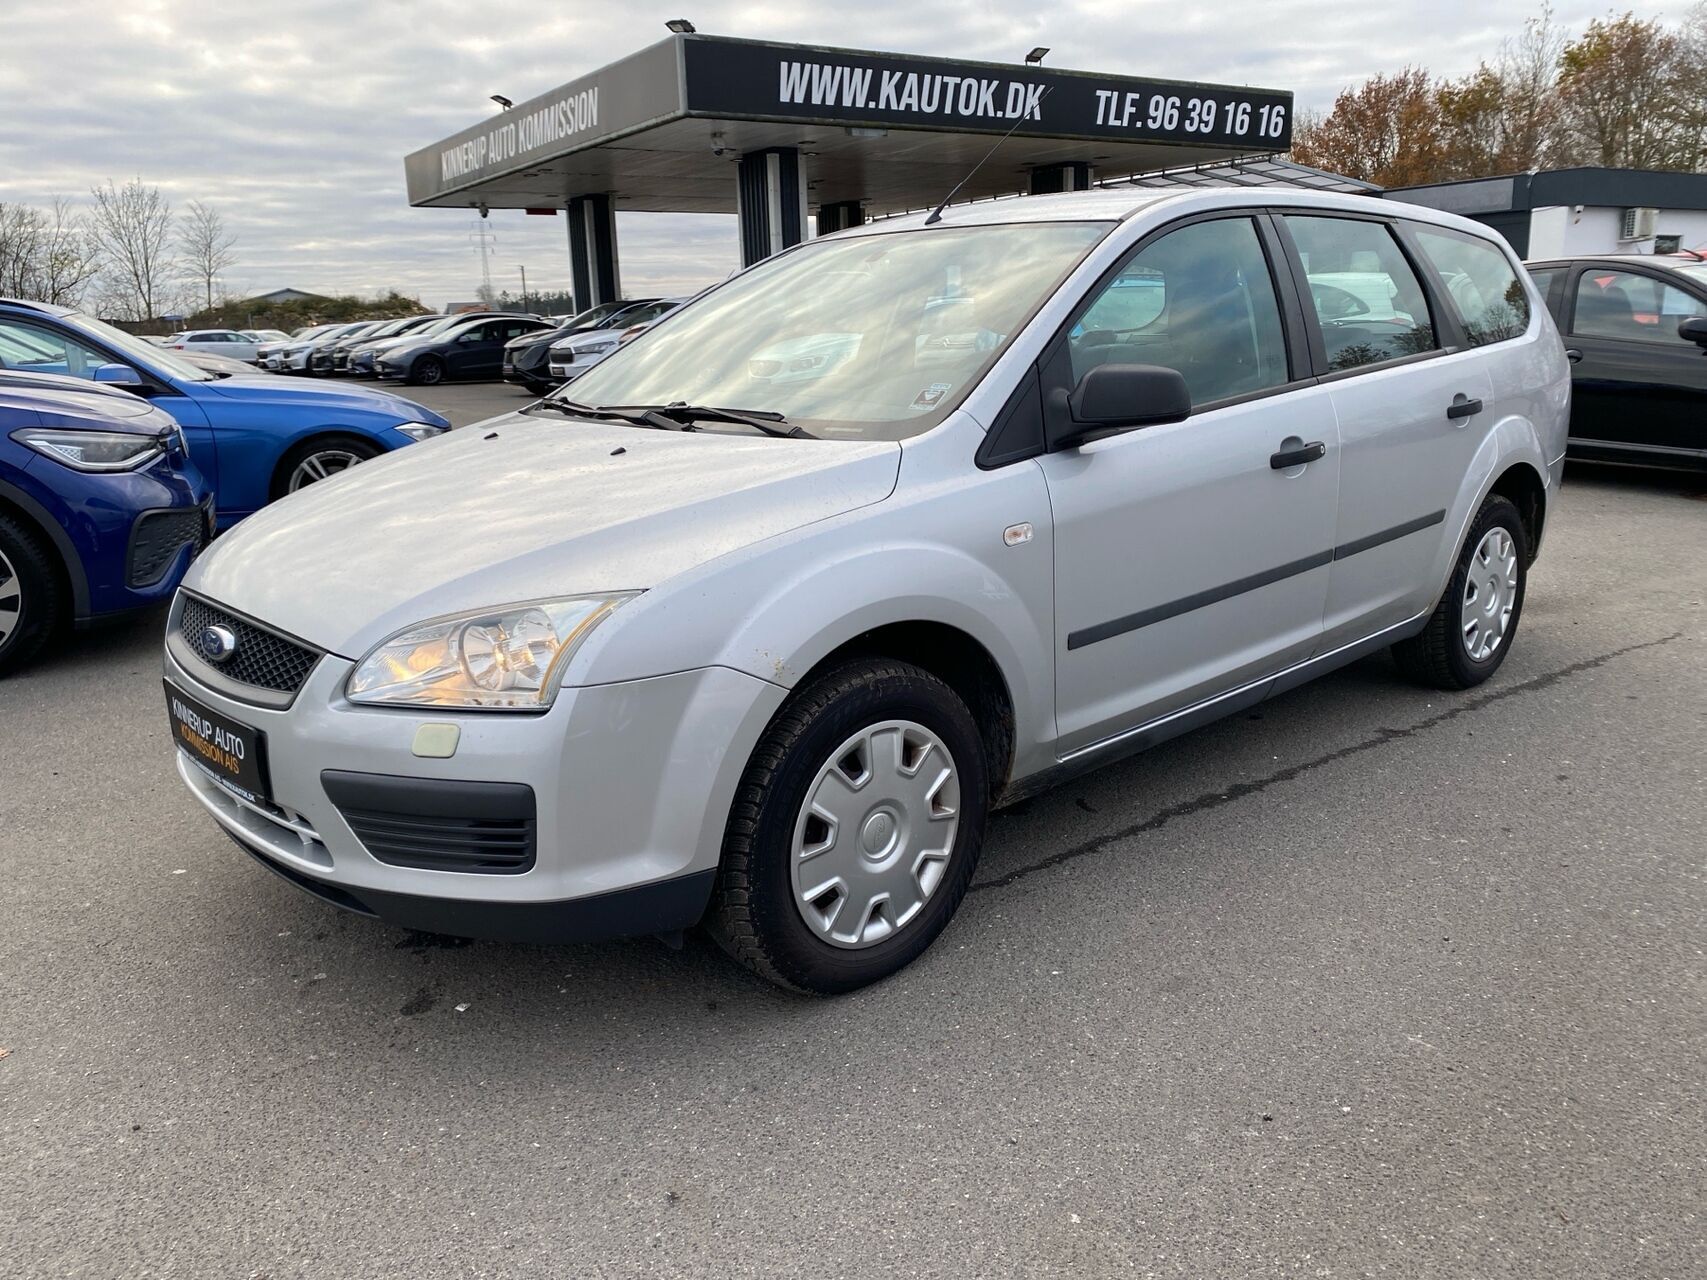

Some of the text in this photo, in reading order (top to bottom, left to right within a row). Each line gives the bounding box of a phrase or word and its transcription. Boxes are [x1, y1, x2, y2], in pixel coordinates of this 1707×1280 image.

[779, 61, 1046, 121] WWW.KAUTOK.DK
[1095, 89, 1285, 138] TLF. 96 39 16 16
[441, 86, 599, 182] KINNERUP AUTO KOMMISSION
[172, 696, 245, 760] KINNERUP AUTO
